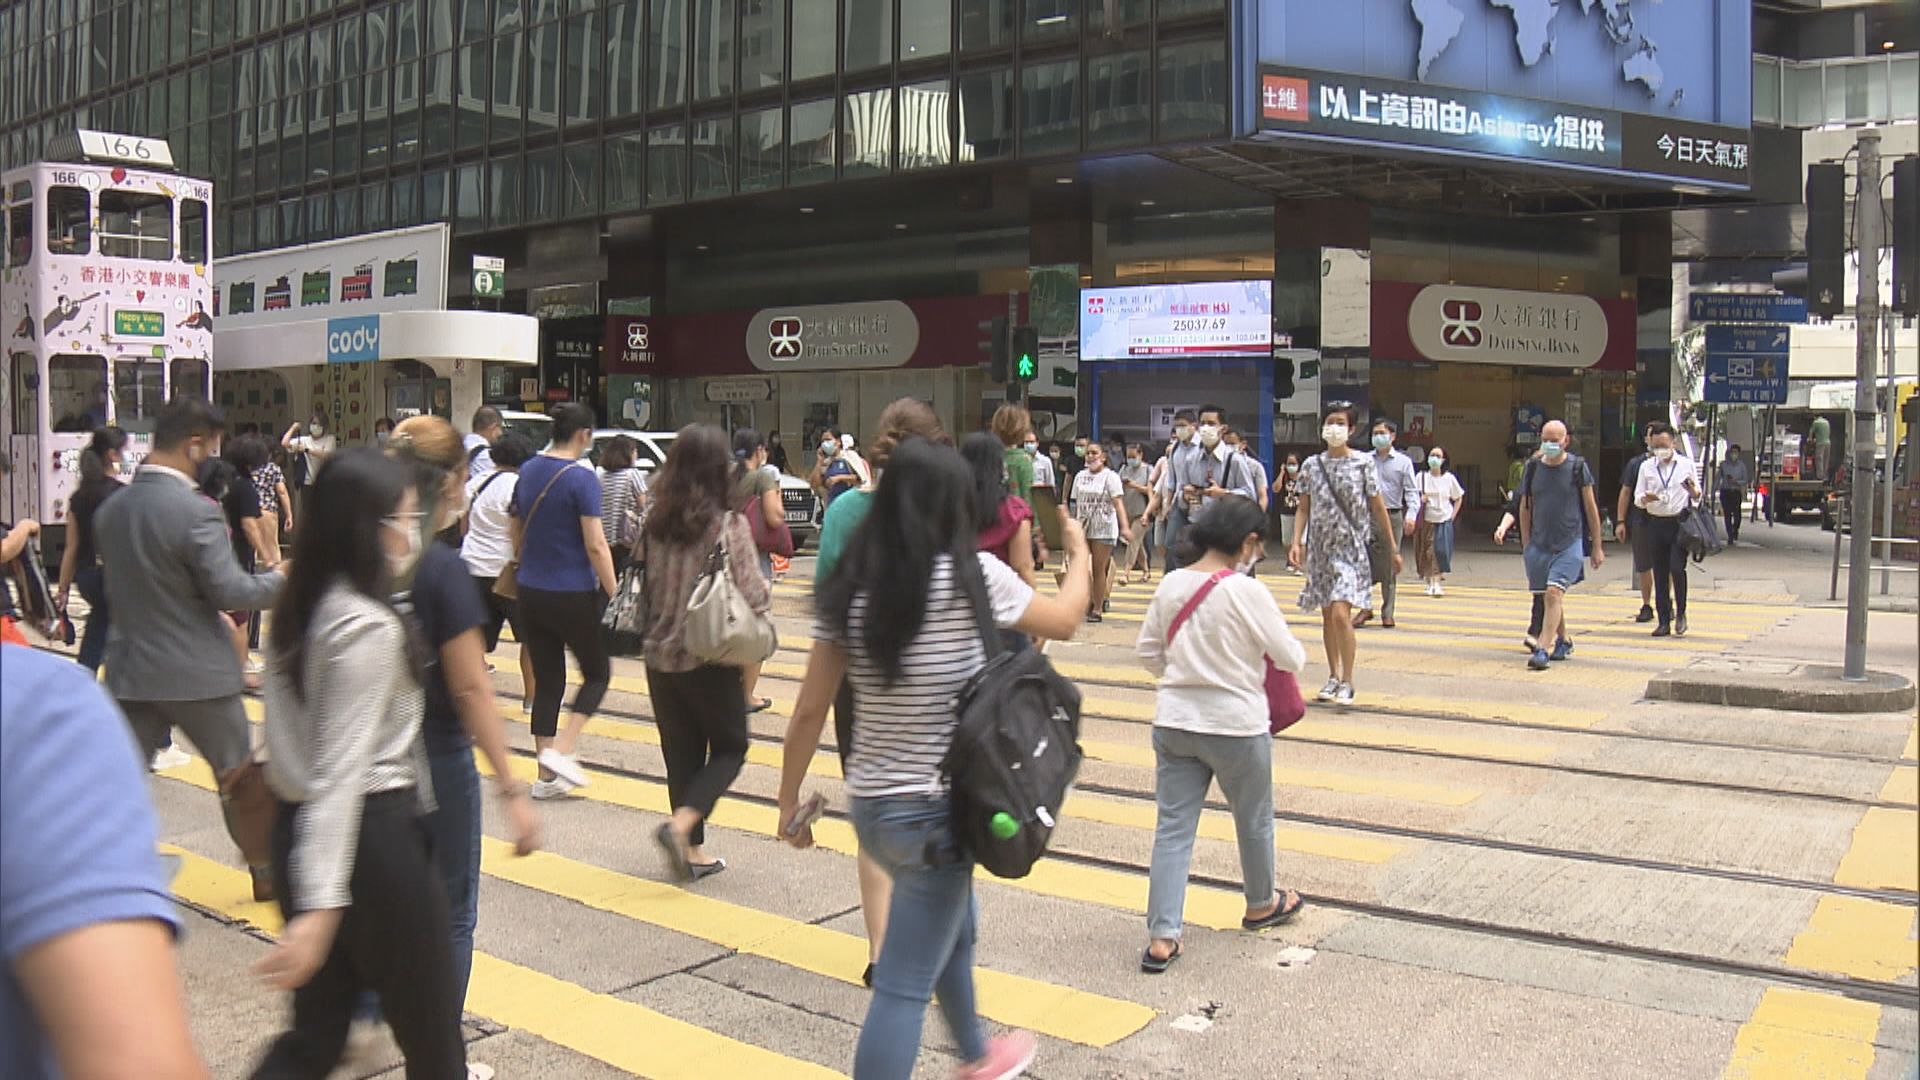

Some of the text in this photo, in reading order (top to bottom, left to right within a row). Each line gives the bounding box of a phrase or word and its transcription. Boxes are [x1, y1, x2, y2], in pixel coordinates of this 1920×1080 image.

[101, 135, 151, 159] 166
[52, 171, 76, 184] 166
[193, 187, 209, 200] 166
[80, 265, 190, 289] 香港小交響樂團
[1212, 302, 1230, 314] HSI
[1739, 296, 1772, 306] Express
[1775, 297, 1803, 305] Station
[118, 312, 140, 323] Happy
[1173, 317, 1227, 332] 25037.69
[1493, 303, 1581, 331] 大新銀行
[806, 313, 889, 338] 大新銀行
[329, 324, 378, 354] cody
[620, 349, 656, 364] 大新銀行
[1728, 378, 1763, 387] Kowloon
